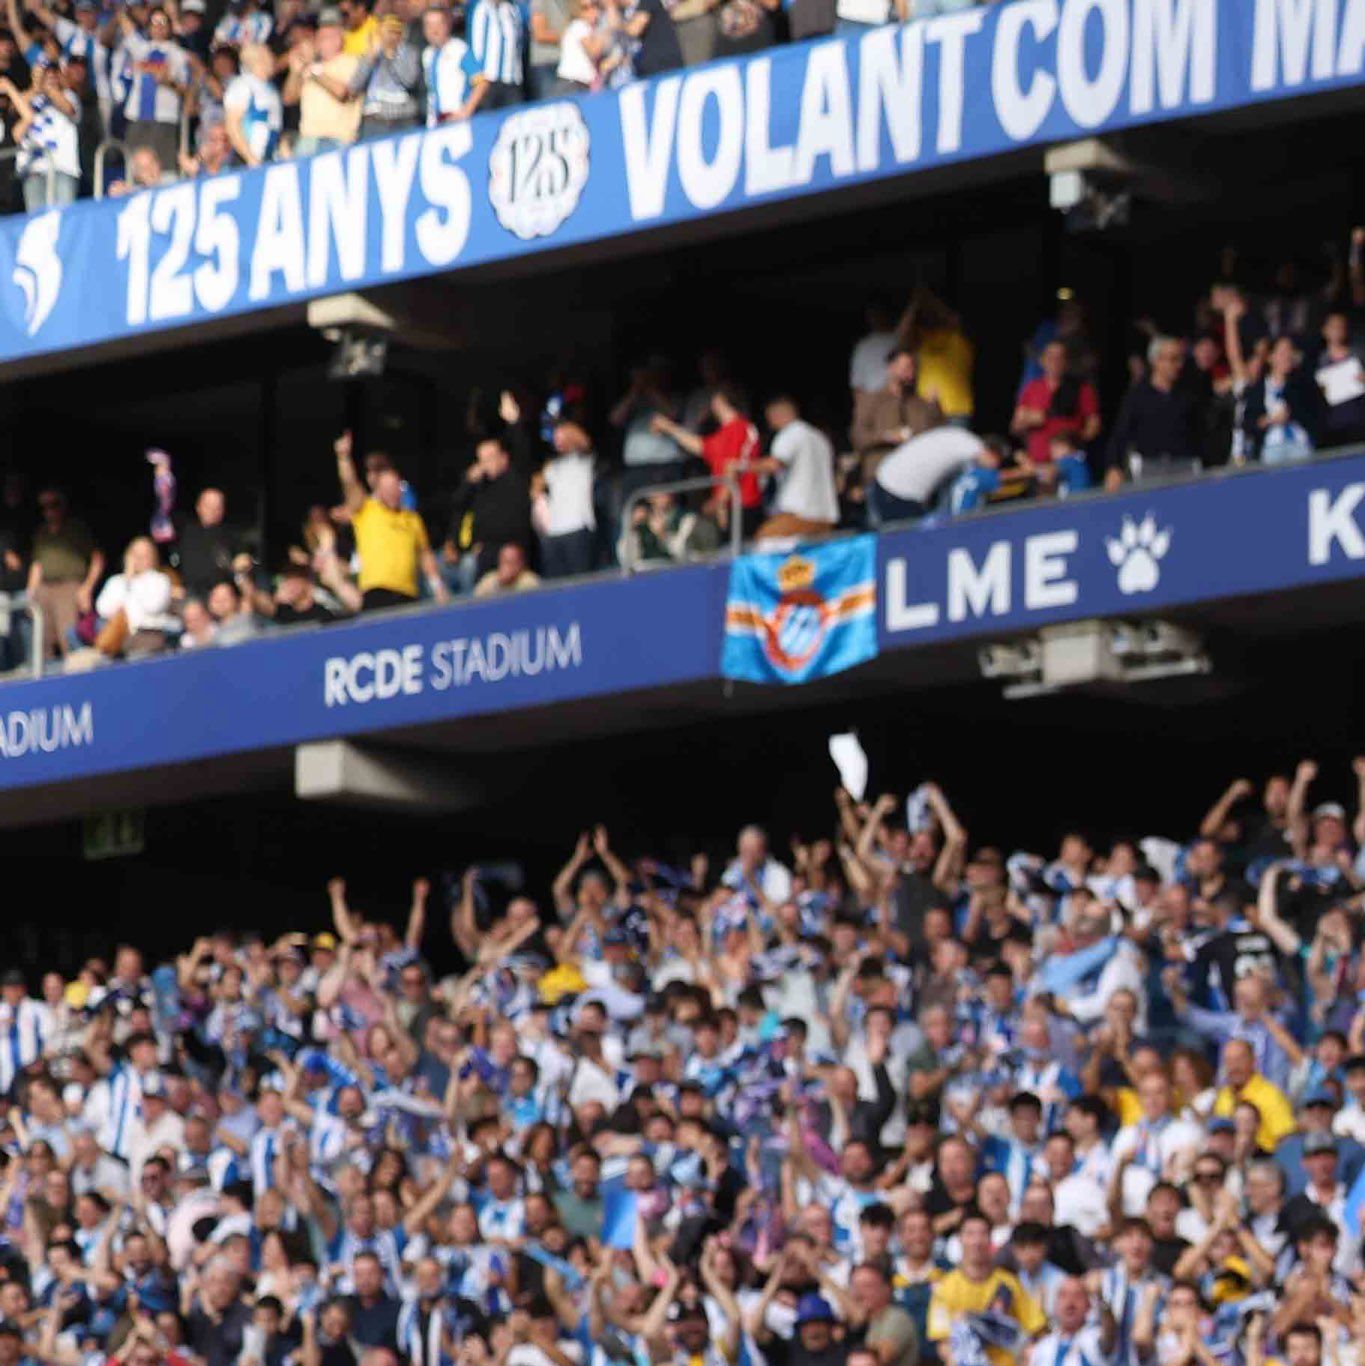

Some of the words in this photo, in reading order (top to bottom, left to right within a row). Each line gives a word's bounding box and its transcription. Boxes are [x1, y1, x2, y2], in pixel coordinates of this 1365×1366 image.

[620, 8, 984, 221] VOLANT
[991, 0, 1217, 141] COM
[115, 175, 241, 325] 125
[249, 123, 474, 301] ANYS
[885, 530, 1080, 633] LME
[323, 644, 424, 708] RCDE
[430, 623, 584, 691] STADIUM
